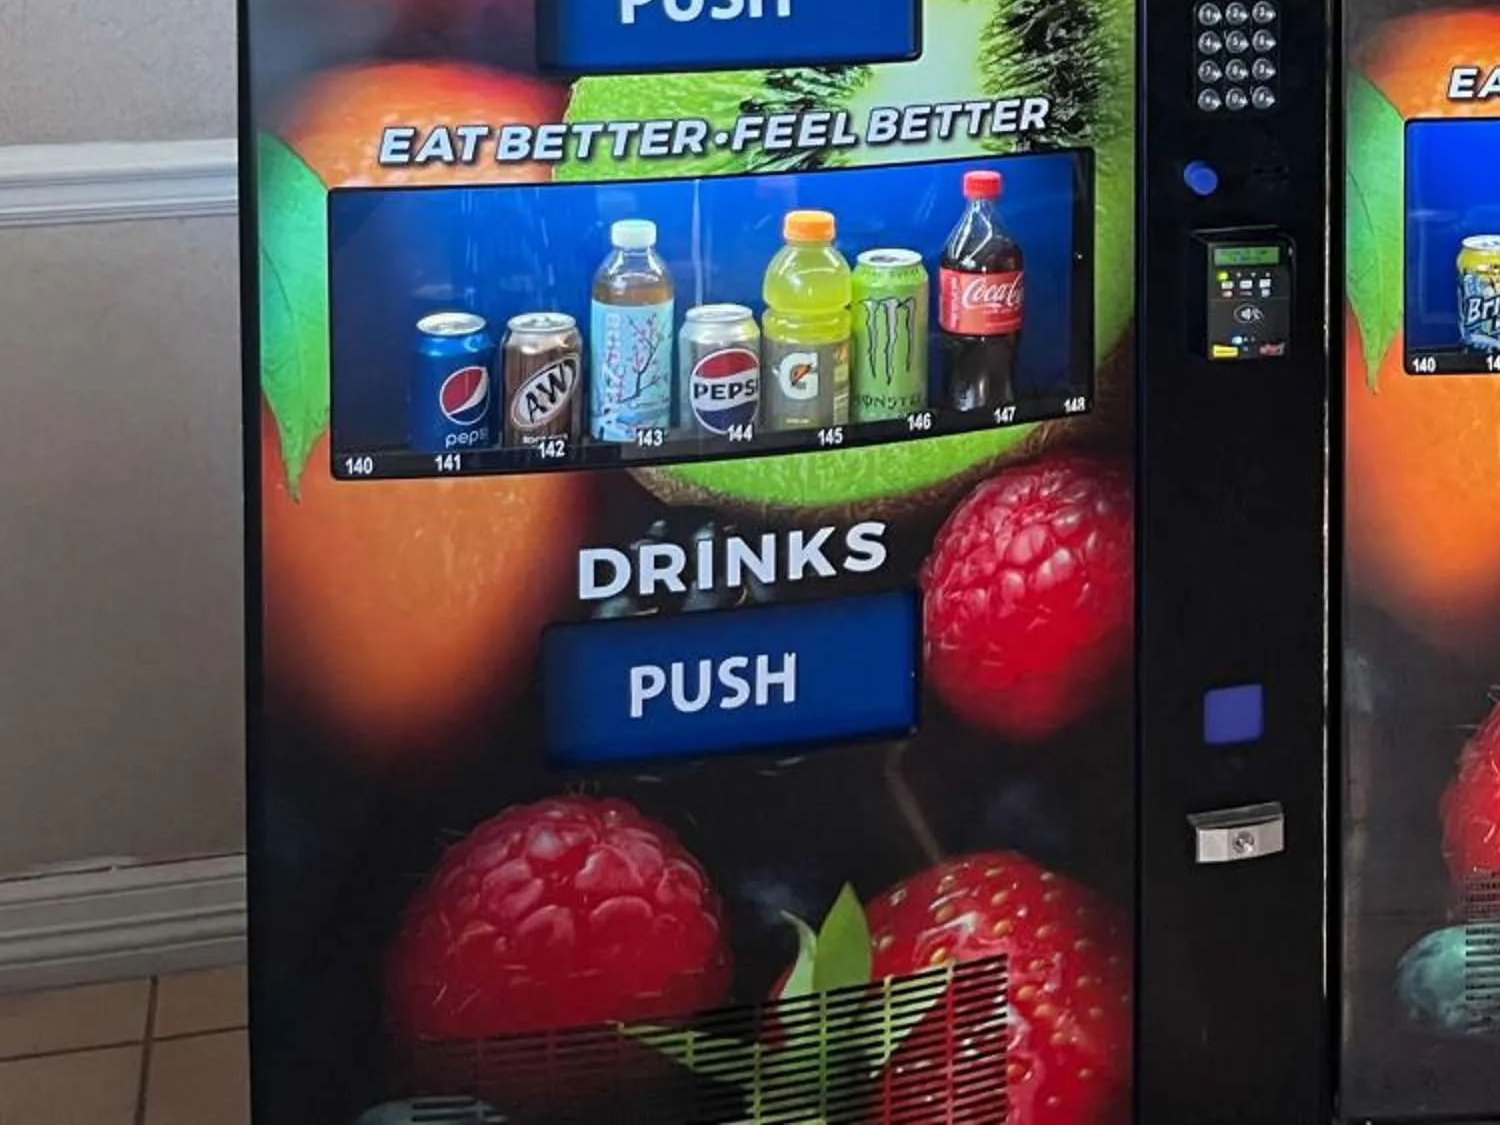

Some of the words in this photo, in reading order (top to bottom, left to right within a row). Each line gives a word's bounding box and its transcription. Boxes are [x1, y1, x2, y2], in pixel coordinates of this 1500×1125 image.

[380, 125, 490, 165] EAT
[496, 120, 705, 162] BETTER
[730, 110, 858, 152] FEEL
[866, 96, 1050, 144] BETTER
[1412, 357, 1437, 373] 140
[779, 352, 819, 400] G
[694, 378, 759, 400] PEPSI
[1064, 397, 1086, 413] 148
[907, 412, 932, 431] 146
[994, 407, 1016, 424] 147
[636, 429, 664, 448] 143
[727, 425, 754, 442] 144
[817, 428, 844, 447] 145
[538, 440, 566, 459] 142
[345, 456, 374, 475] 140
[434, 454, 462, 472] 141
[578, 521, 888, 601] DRINKS
[629, 651, 797, 718] PUSH
